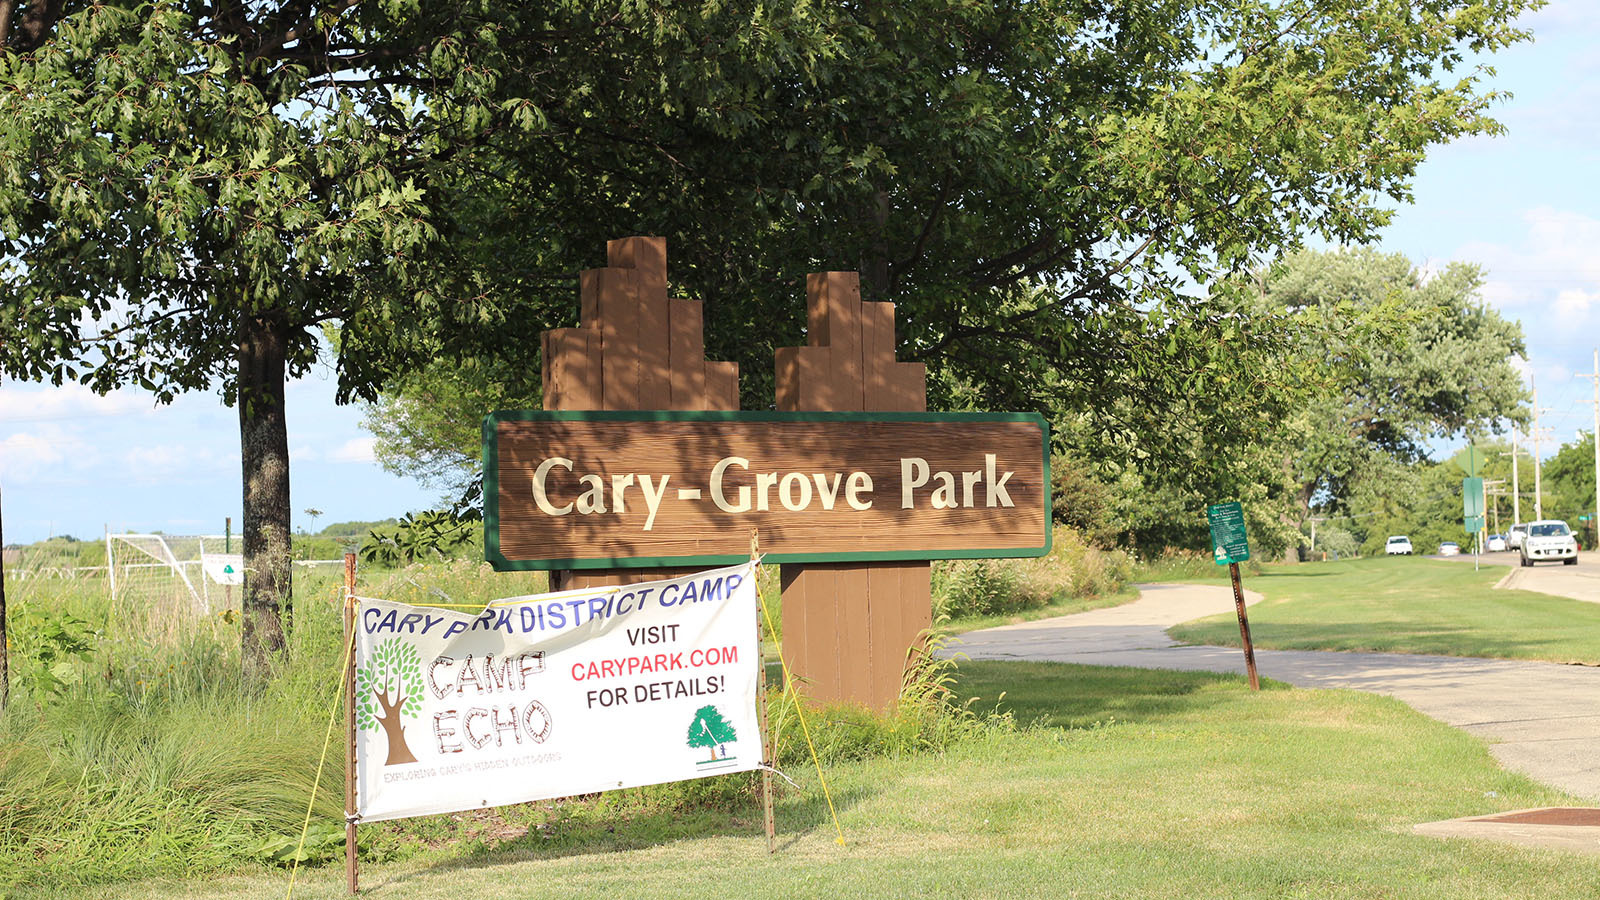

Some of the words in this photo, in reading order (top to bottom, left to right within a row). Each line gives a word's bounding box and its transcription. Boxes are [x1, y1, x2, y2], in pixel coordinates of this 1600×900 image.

[532, 456, 874, 531] Cary-Grove
[900, 453, 1015, 510] Park
[364, 608, 445, 635] CARY
[442, 608, 514, 640] PRK
[519, 588, 655, 633] DISTRICT
[658, 574, 743, 607] CAMP
[626, 624, 680, 646] VISIT
[427, 650, 546, 700] CAMP
[571, 646, 739, 681] CARYPARK.COM
[586, 687, 629, 709] FOR
[634, 675, 726, 703] DETAILS!
[432, 699, 552, 755] ECHO
[383, 768, 437, 784] EXPLORING
[439, 762, 472, 776] CARY'S
[474, 759, 509, 772] HIDDEN
[512, 751, 562, 767] OUTDOORS
